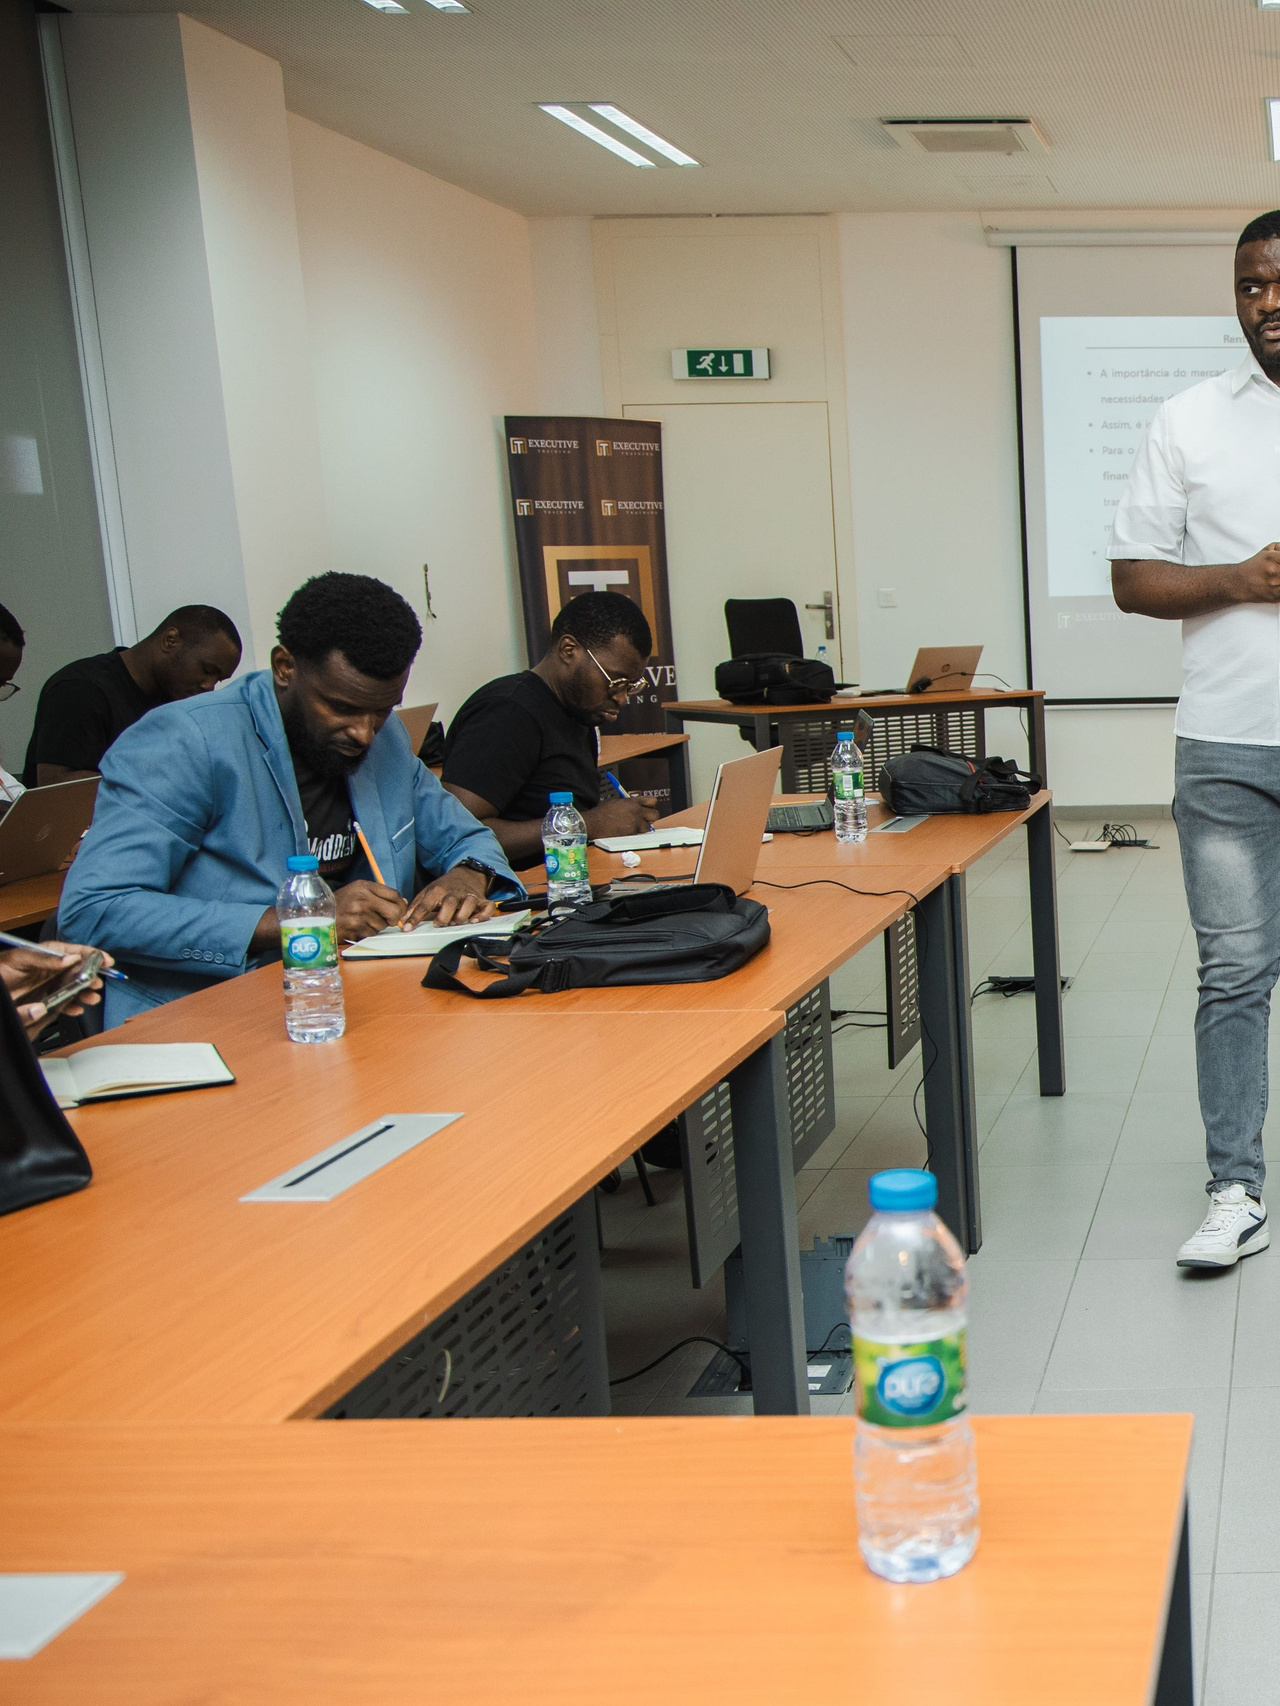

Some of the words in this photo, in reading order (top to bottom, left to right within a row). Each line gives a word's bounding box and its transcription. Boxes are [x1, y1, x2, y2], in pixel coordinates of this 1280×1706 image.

[1100, 368, 1108, 378] A
[1111, 368, 1170, 380] importância
[1173, 367, 1187, 378] do
[1101, 393, 1165, 404] necessidades
[1101, 420, 1133, 431] Assim,
[1135, 419, 1142, 429] é
[528, 438, 579, 449] EXECUTIVE
[612, 441, 660, 452] EXECUTIVE
[1102, 445, 1123, 455] Para
[1127, 447, 1135, 455] o
[534, 500, 584, 509] EXECUTIVE
[617, 501, 663, 510] EXECUTIVE
[291, 942, 318, 954] pura
